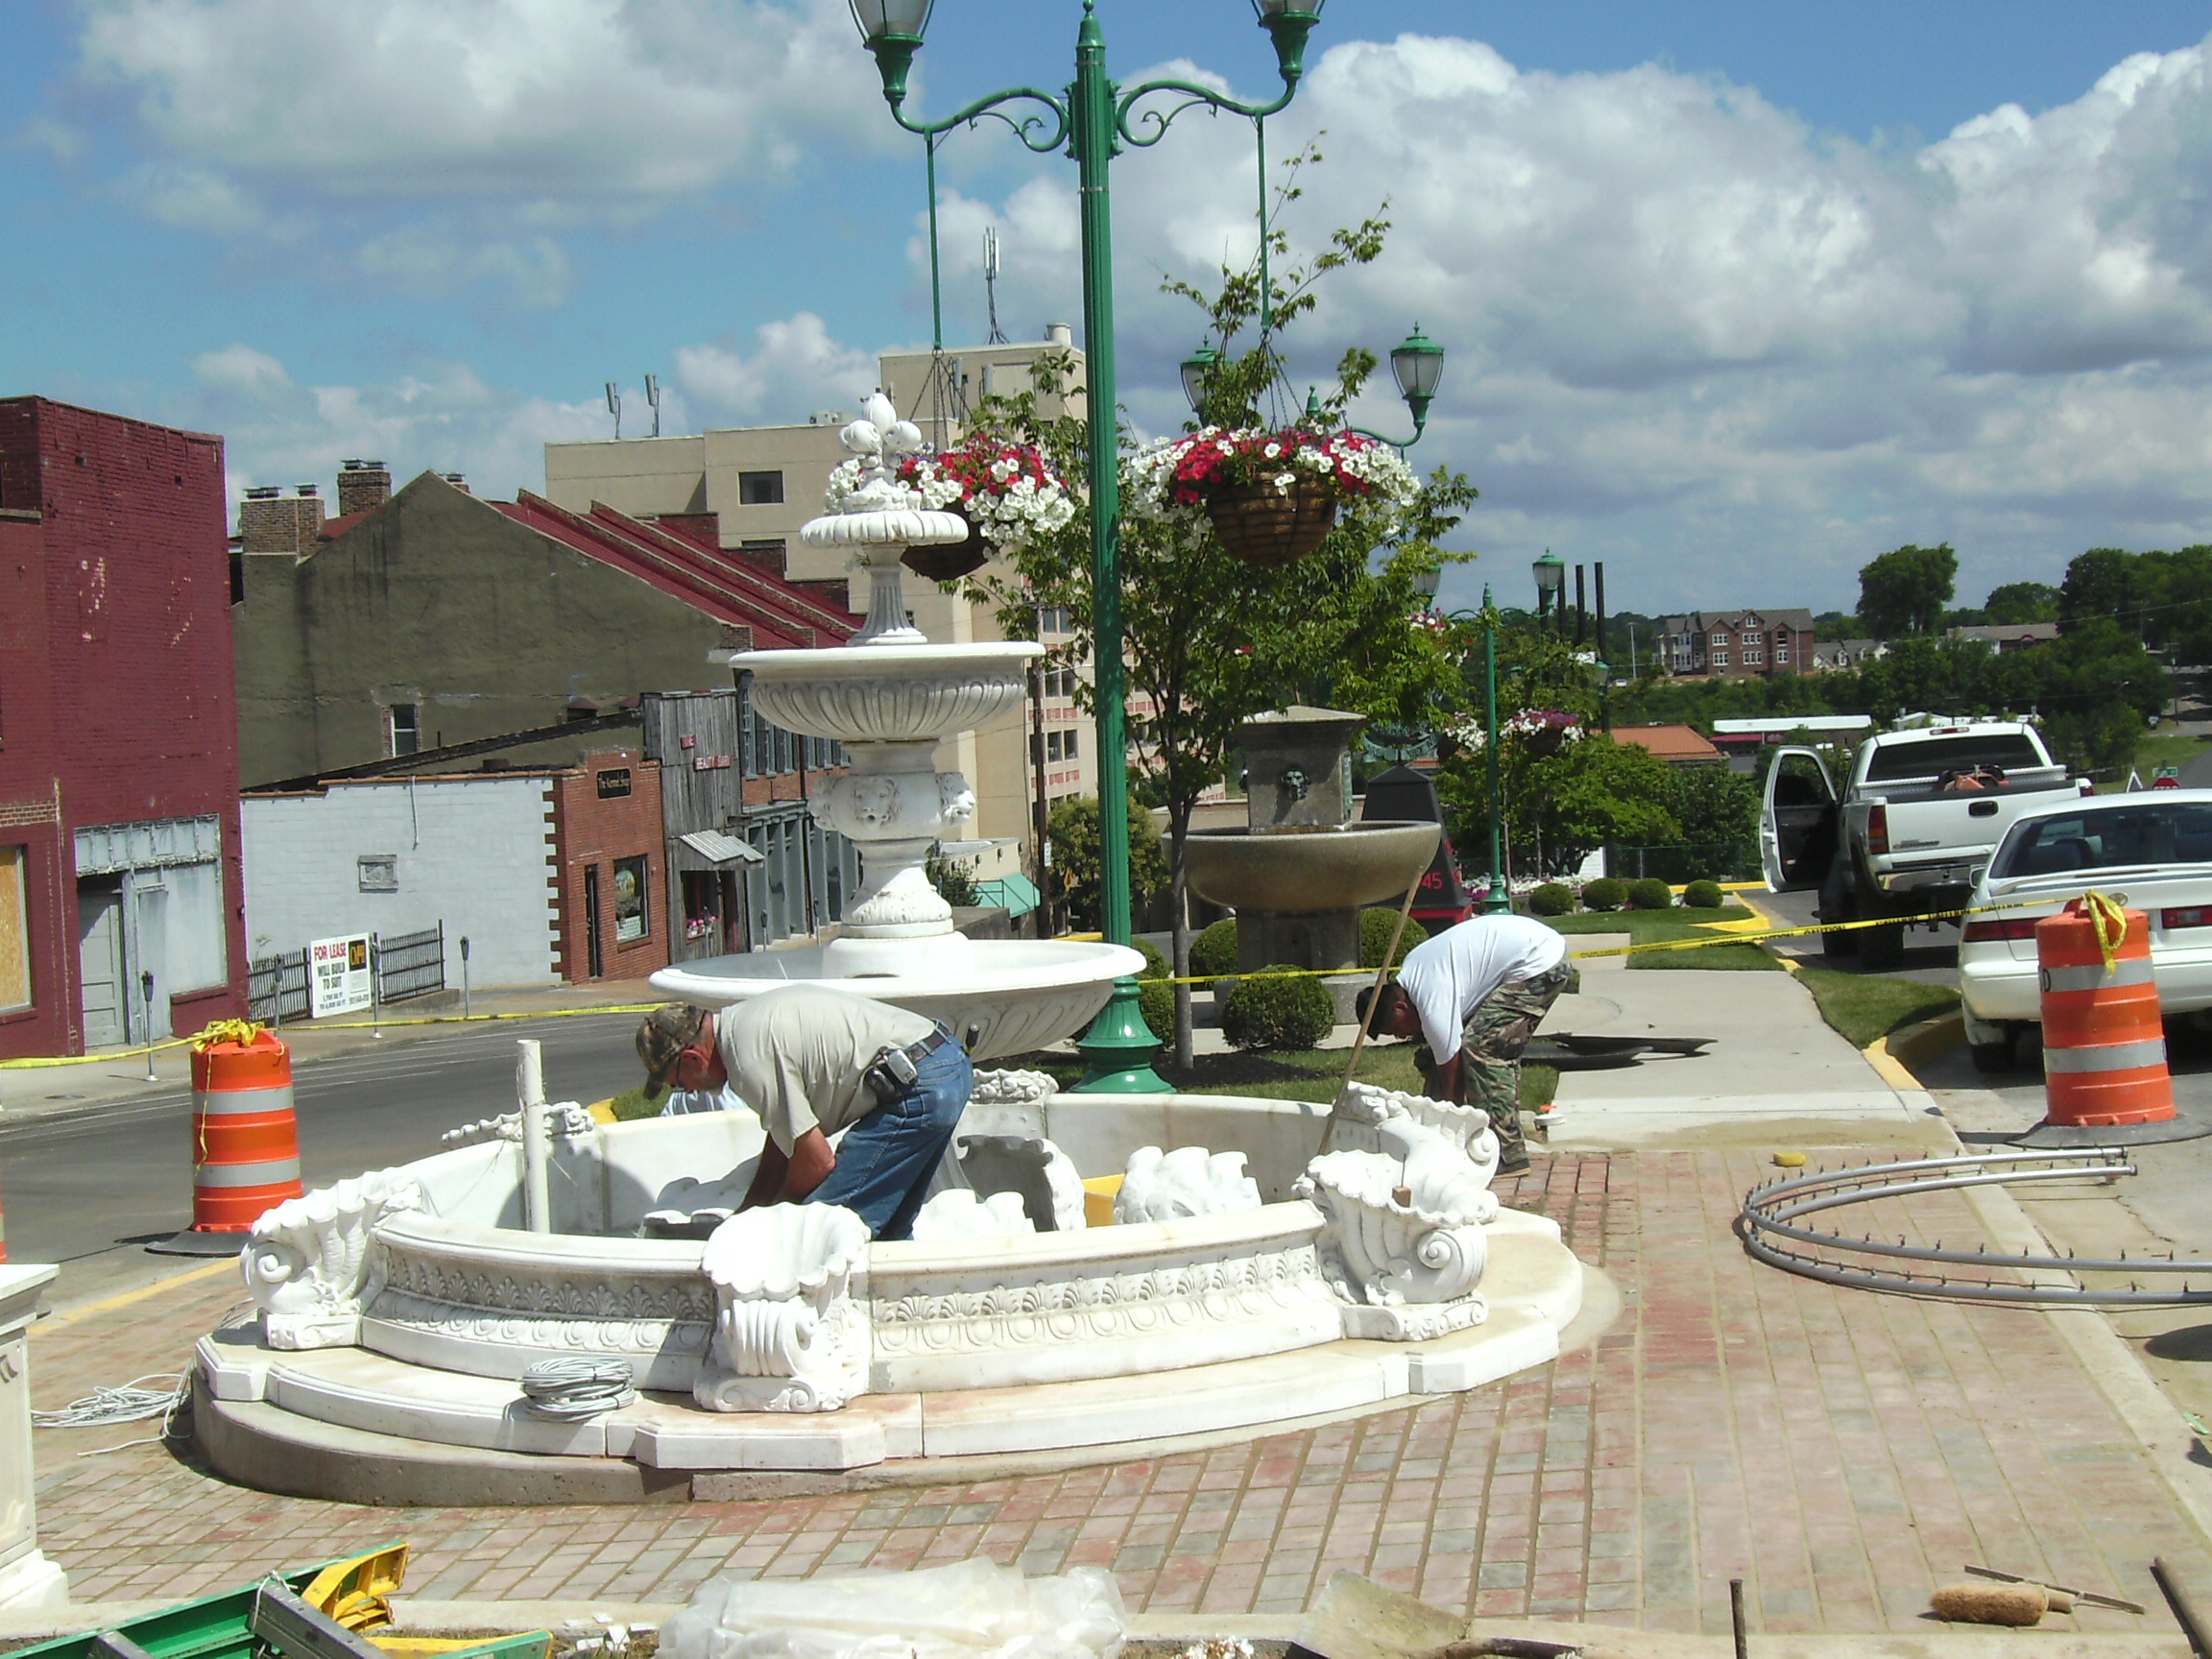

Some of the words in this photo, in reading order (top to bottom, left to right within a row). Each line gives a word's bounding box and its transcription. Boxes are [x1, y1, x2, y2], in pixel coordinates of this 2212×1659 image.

[314, 945, 328, 961] FOR
[329, 942, 347, 959] LEASE
[323, 977, 330, 990] TO
